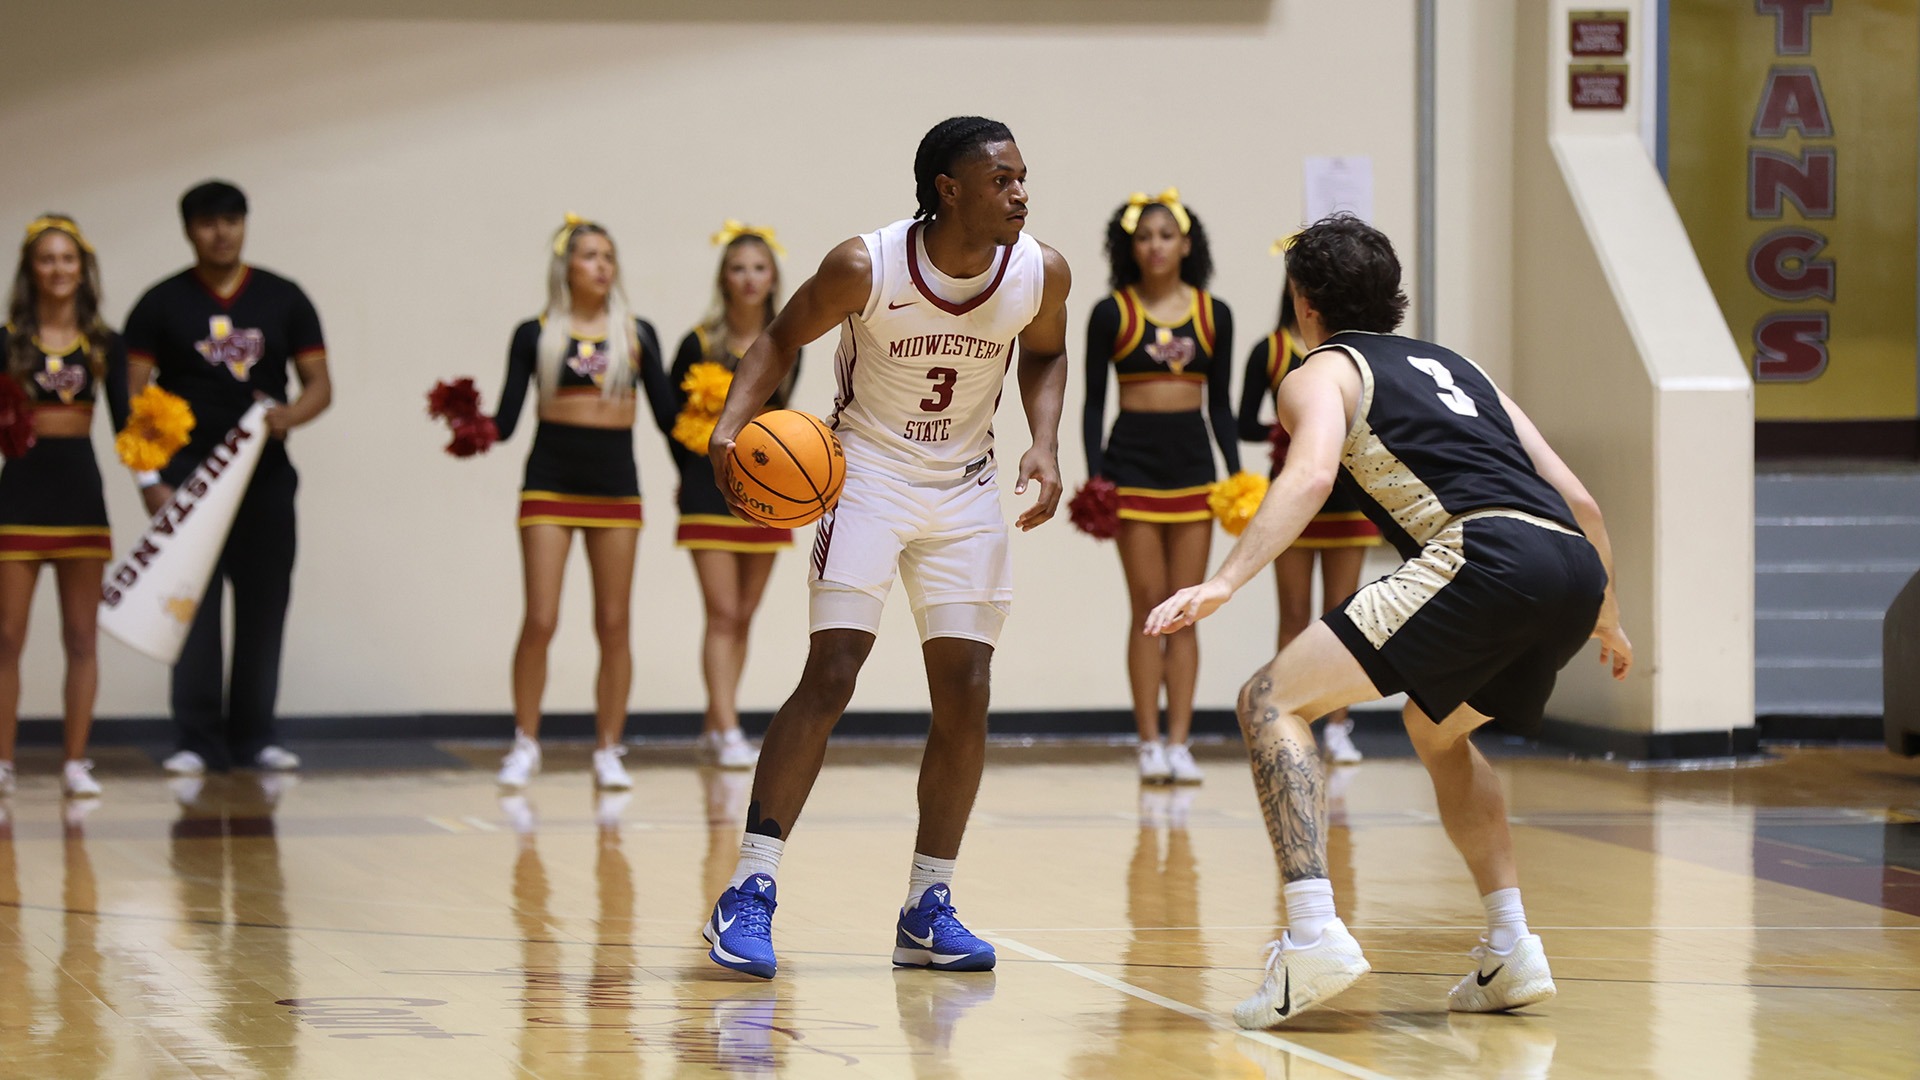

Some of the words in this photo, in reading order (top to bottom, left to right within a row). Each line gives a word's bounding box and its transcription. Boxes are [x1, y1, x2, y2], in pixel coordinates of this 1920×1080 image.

[1748, 0, 1837, 384] TANGS
[889, 333, 1004, 360] MIDWESTERN
[918, 366, 959, 412] 3
[1406, 355, 1479, 418] 3
[903, 418, 952, 442] STATE
[101, 424, 252, 609] MUSTANGS
